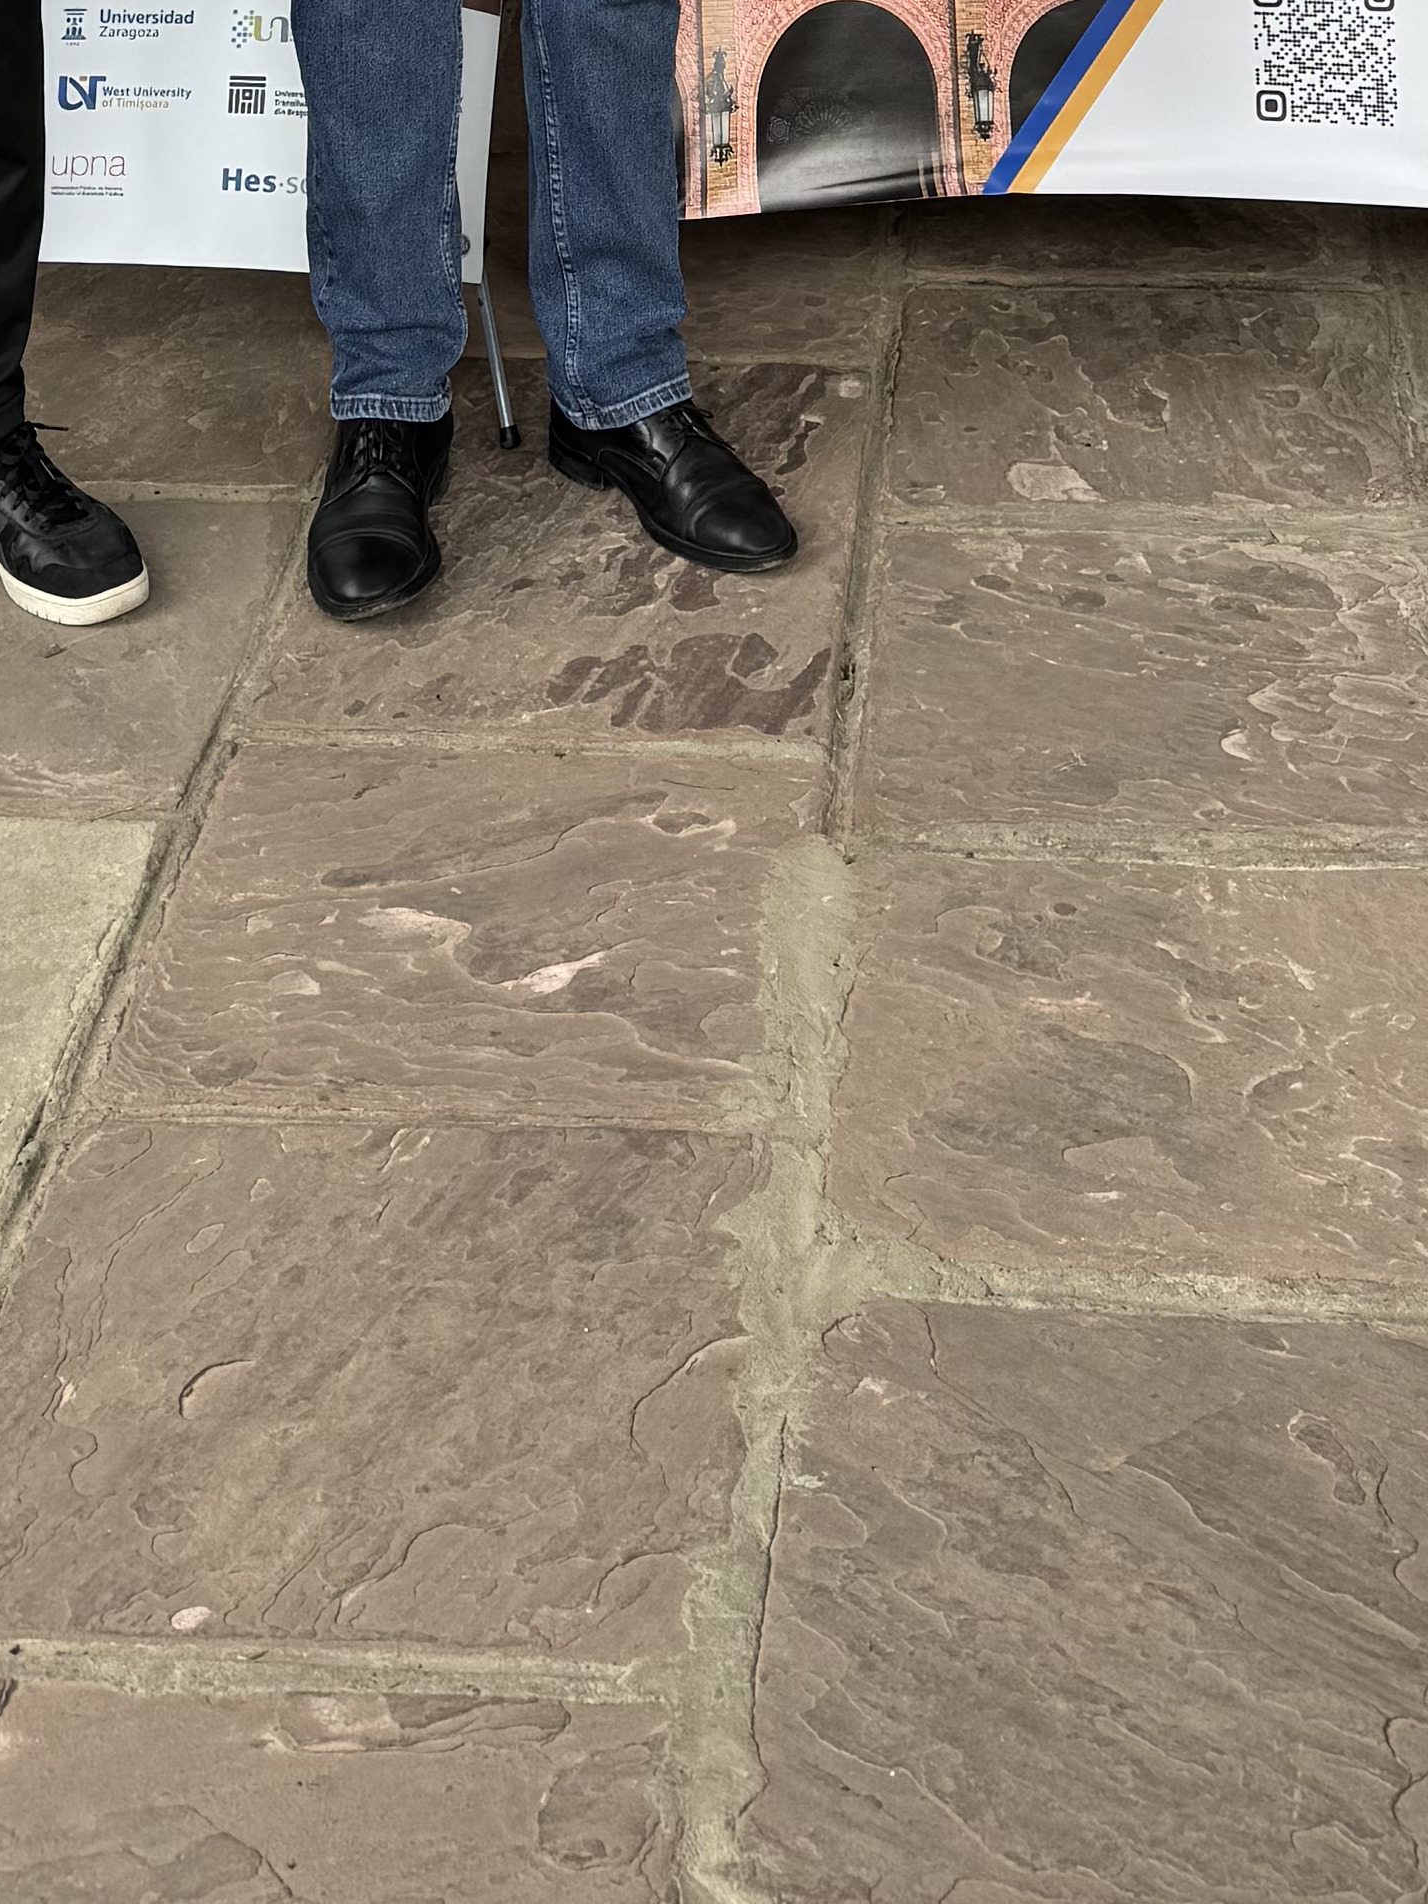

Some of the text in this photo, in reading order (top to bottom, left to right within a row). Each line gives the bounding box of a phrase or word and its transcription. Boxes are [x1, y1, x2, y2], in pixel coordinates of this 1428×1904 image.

[99, 8, 195, 25] Universidad
[99, 26, 160, 41] Zaragoza
[102, 86, 192, 100] West University
[102, 98, 114, 108] of
[52, 155, 126, 182] upna
